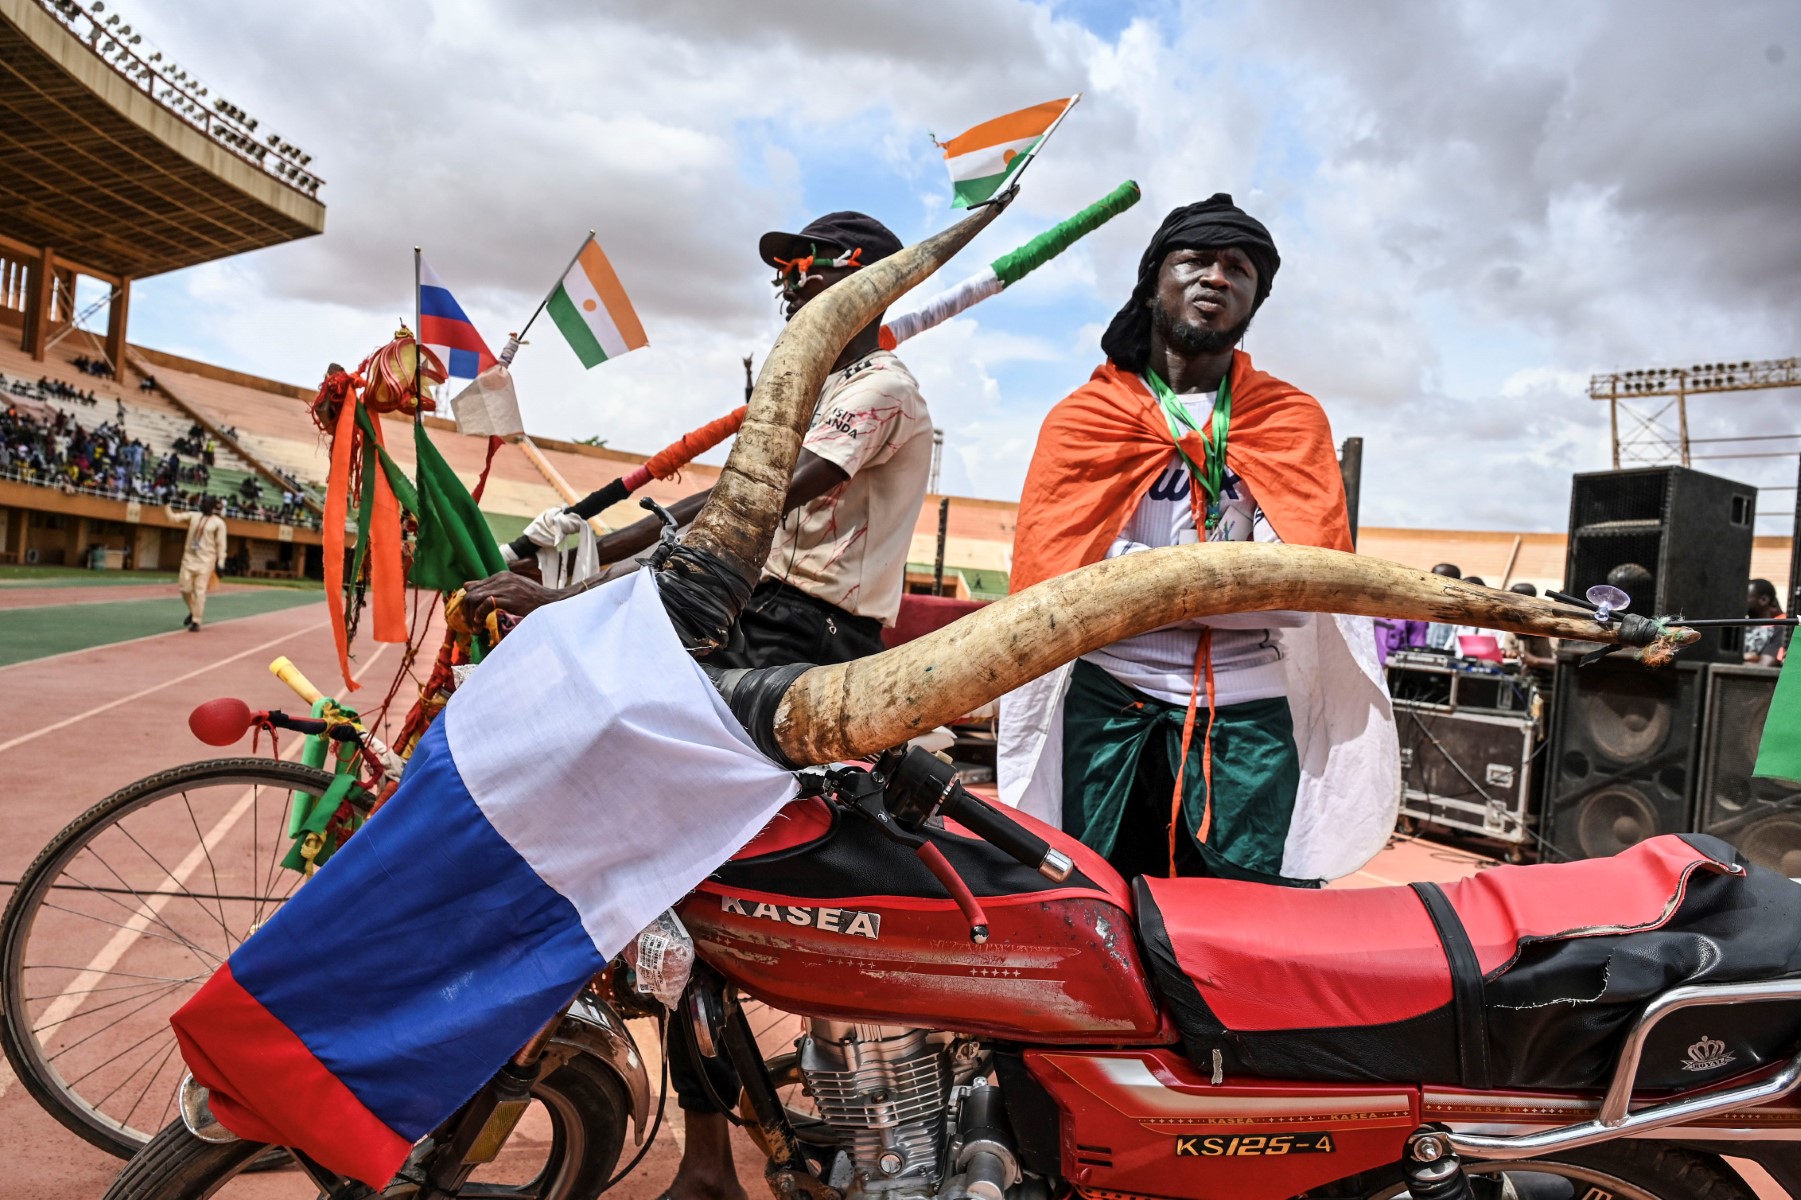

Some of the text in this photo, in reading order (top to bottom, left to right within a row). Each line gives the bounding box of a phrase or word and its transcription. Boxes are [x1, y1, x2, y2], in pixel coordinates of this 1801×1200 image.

[831, 407, 856, 423] ISIT
[721, 896, 877, 939] KASEA
[1330, 1112, 1378, 1121] KASEA
[1464, 1105, 1511, 1113] KASEA
[1176, 1135, 1333, 1156] KS125-4
